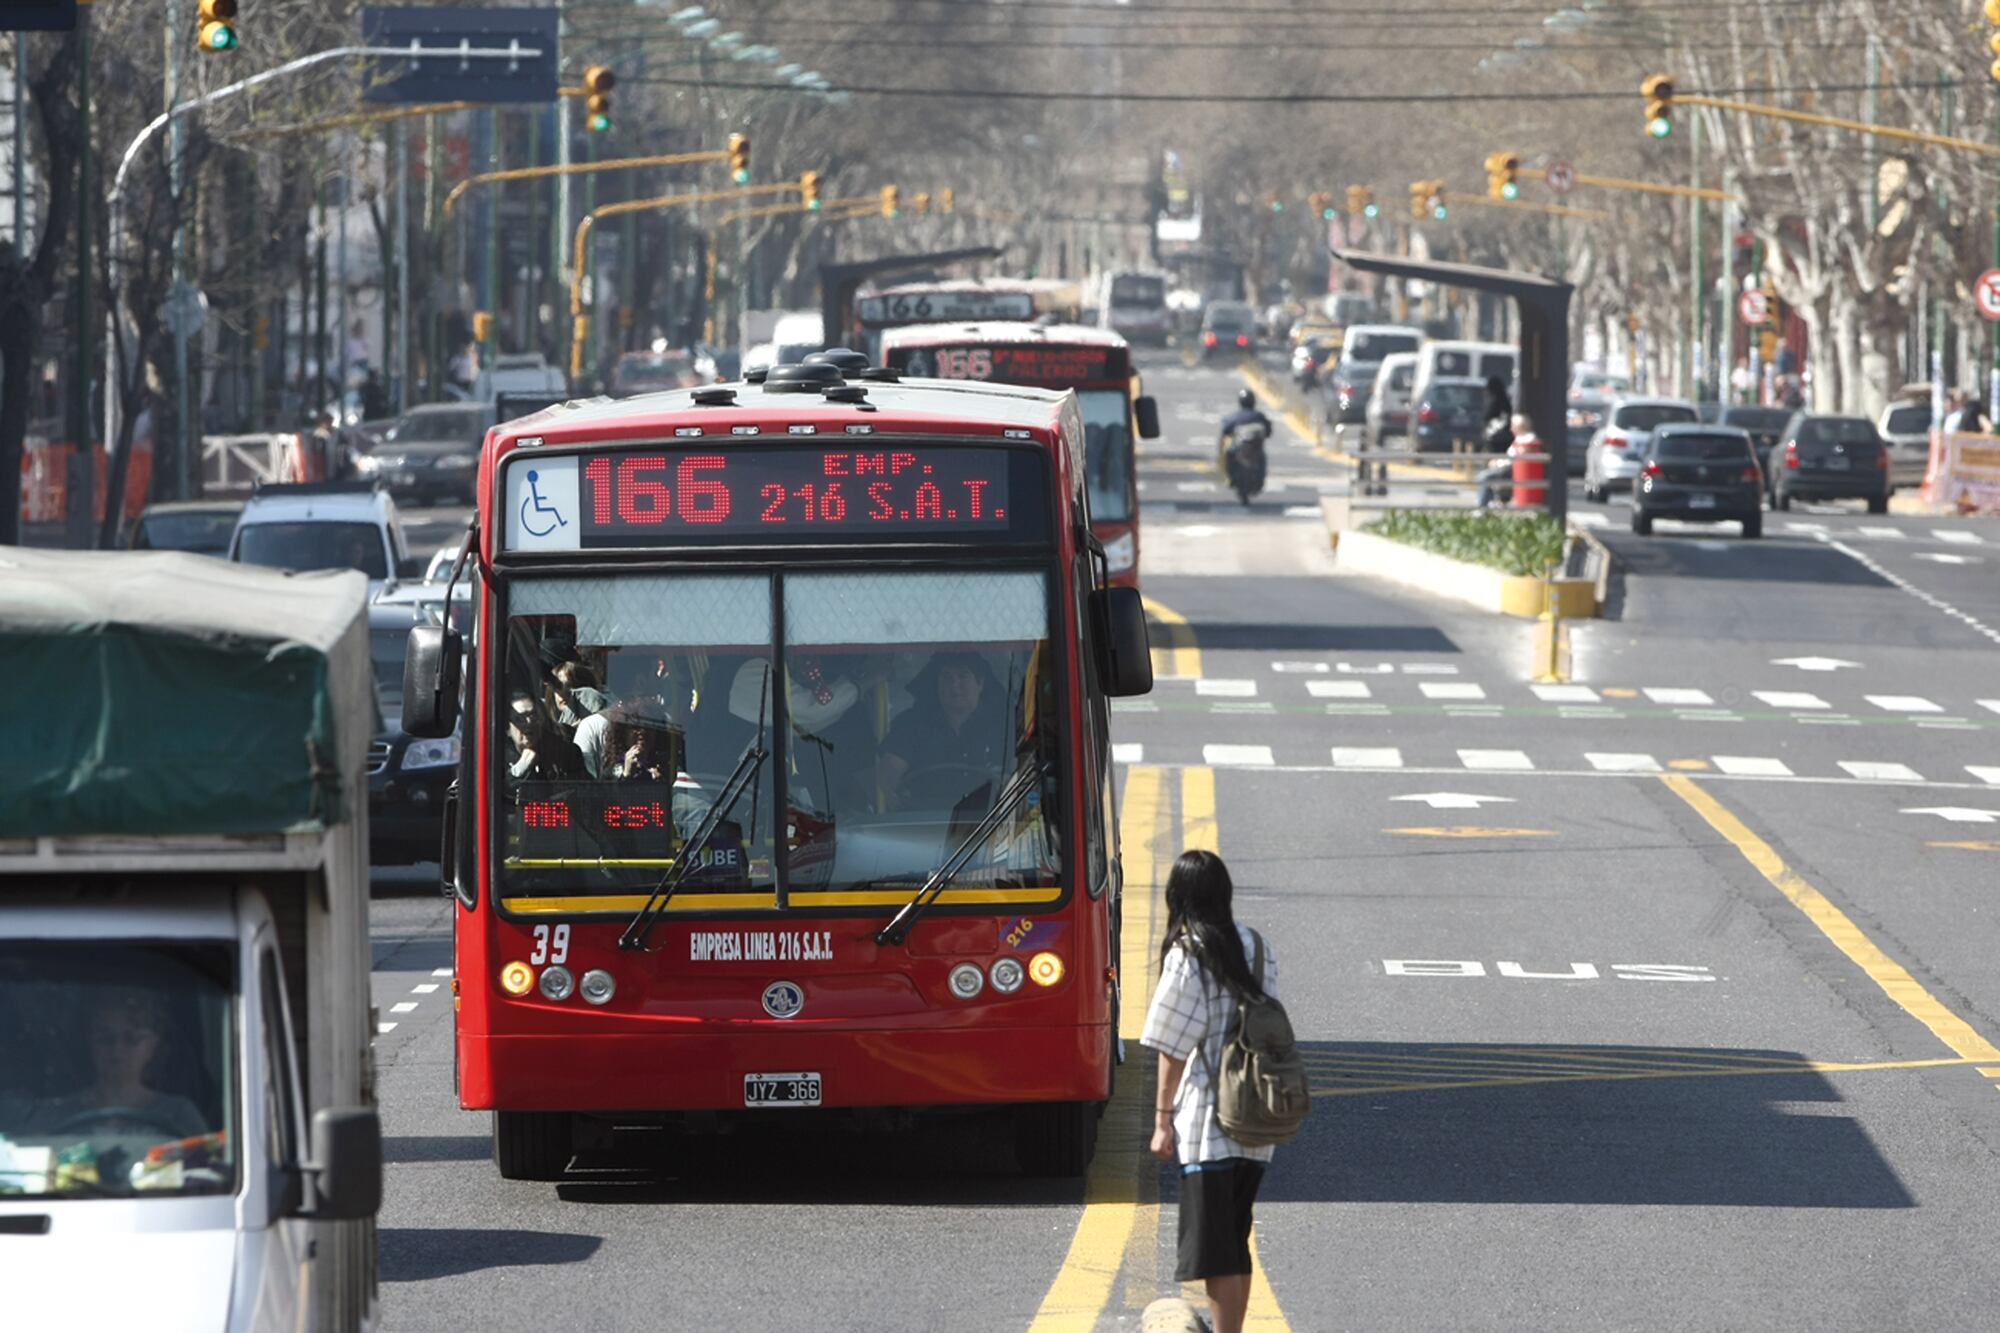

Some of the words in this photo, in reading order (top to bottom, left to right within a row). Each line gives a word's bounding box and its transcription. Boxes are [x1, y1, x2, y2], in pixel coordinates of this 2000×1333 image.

[882, 295, 932, 318] 166
[935, 349, 992, 380] 166
[823, 453, 934, 477] EMP.
[585, 456, 731, 525] 166
[759, 483, 848, 522] 216
[867, 480, 1006, 521] S.A.T.
[1271, 661, 1460, 675] BUS
[604, 802, 665, 828] est
[687, 849, 738, 868] SUBE
[530, 924, 571, 966] 39
[1006, 918, 1034, 948] 216
[690, 932, 743, 961] EMPRESA
[744, 932, 777, 961] LINEA
[778, 932, 801, 961] 216
[803, 932, 832, 961] S.A.T.
[1382, 959, 1717, 982] BUS
[748, 1082, 778, 1101] JYZ
[787, 1081, 818, 1100] 366
